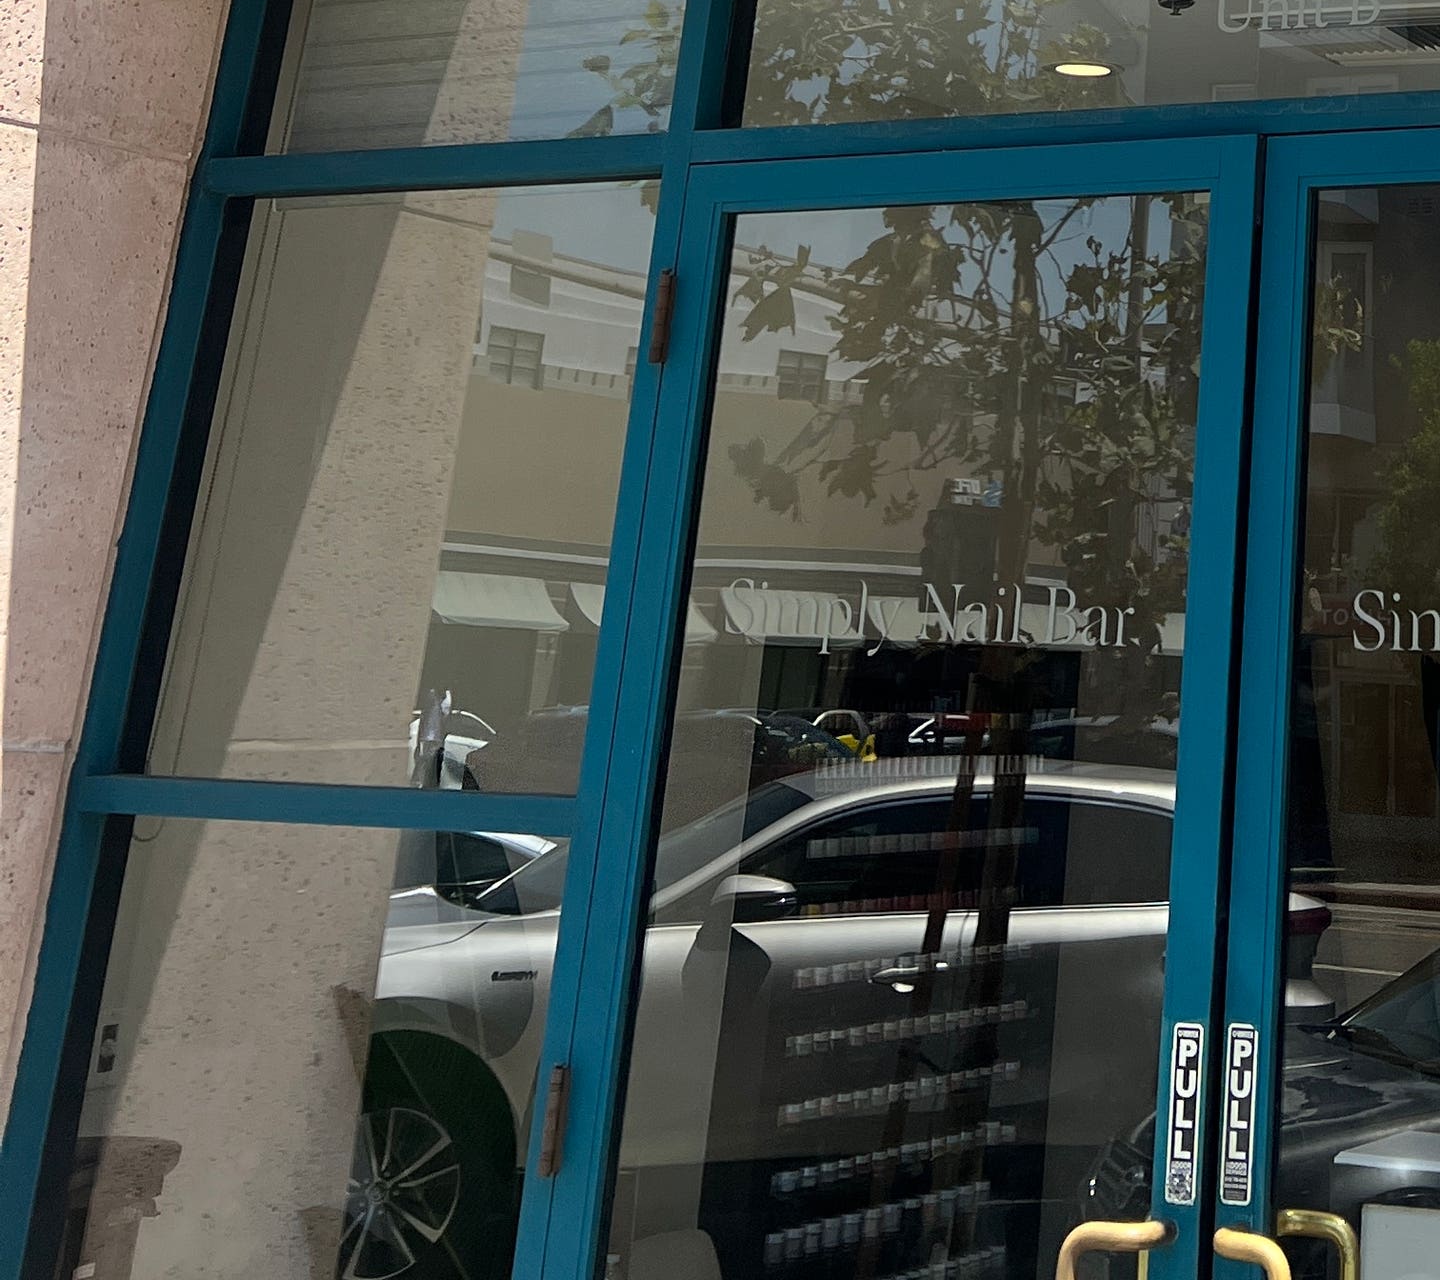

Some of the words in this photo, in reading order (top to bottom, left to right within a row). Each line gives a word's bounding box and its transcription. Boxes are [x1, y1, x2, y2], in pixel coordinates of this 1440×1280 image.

[723, 577, 904, 657] Simply
[917, 583, 1022, 648] Nail
[1045, 585, 1136, 648] Bar
[1173, 1038, 1198, 1160] PULL
[1227, 1038, 1253, 1160] PULL
